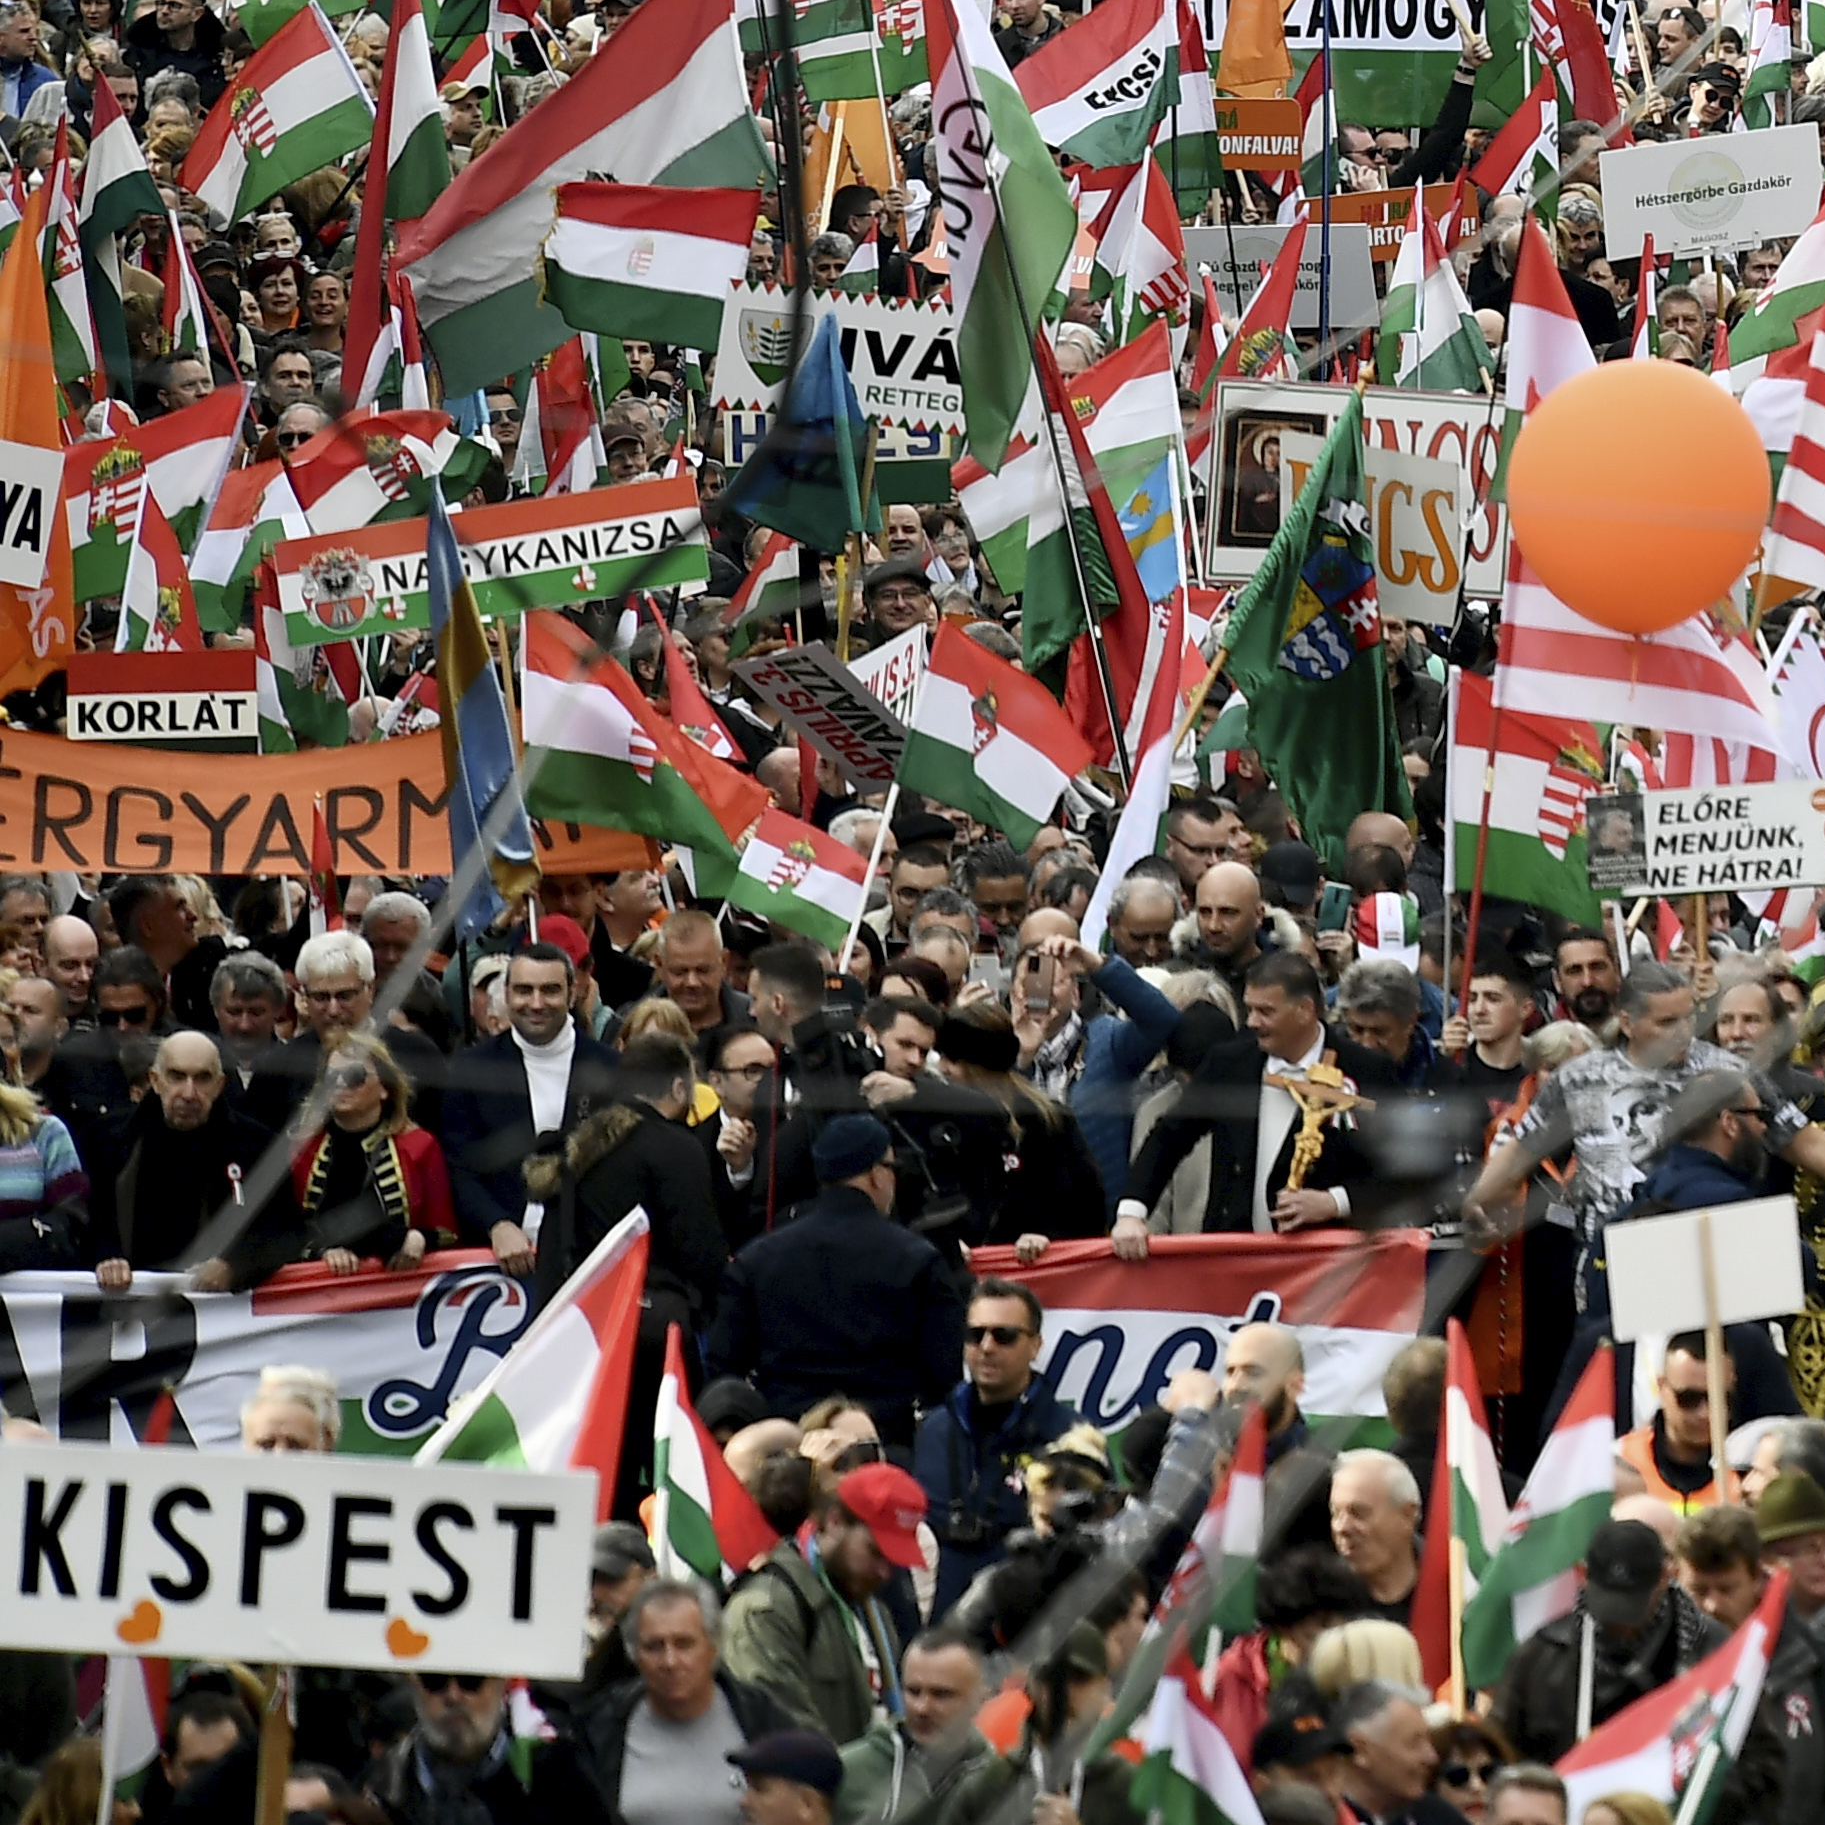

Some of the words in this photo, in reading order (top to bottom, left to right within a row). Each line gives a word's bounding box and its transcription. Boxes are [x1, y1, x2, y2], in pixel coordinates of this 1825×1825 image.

[1635, 183, 1725, 210] Hétszergörbe
[1727, 173, 1793, 195] Gazdakör
[76, 698, 247, 734] KORLÁT
[1657, 797, 1751, 826] ELŐRE
[1652, 825, 1803, 857] MENJÜNK,
[1648, 867, 1687, 888] NE
[1697, 857, 1803, 886] HÁTRA!
[20, 1478, 555, 1621] KISPEST
